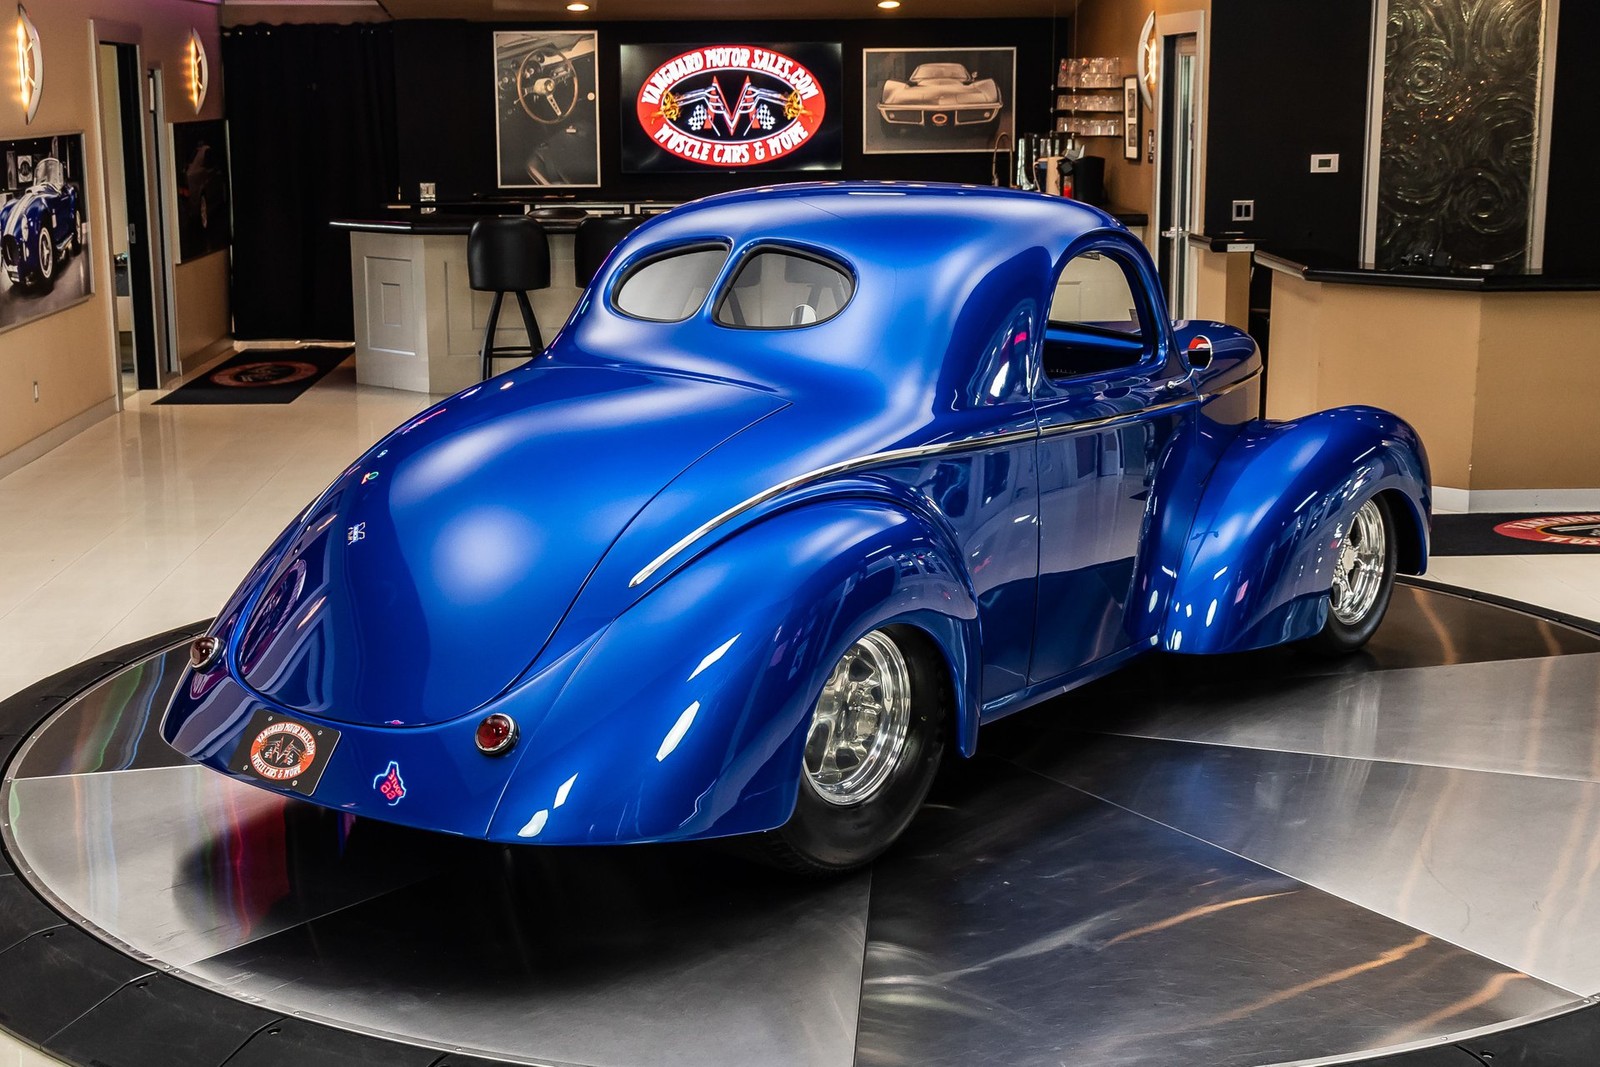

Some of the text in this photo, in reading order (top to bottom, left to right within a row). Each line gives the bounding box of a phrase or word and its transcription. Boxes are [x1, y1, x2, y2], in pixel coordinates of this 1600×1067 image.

[642, 48, 819, 105] VANGUARD MOTOR SALES.COM
[653, 121, 809, 163] MUSCLE CARS & MORE
